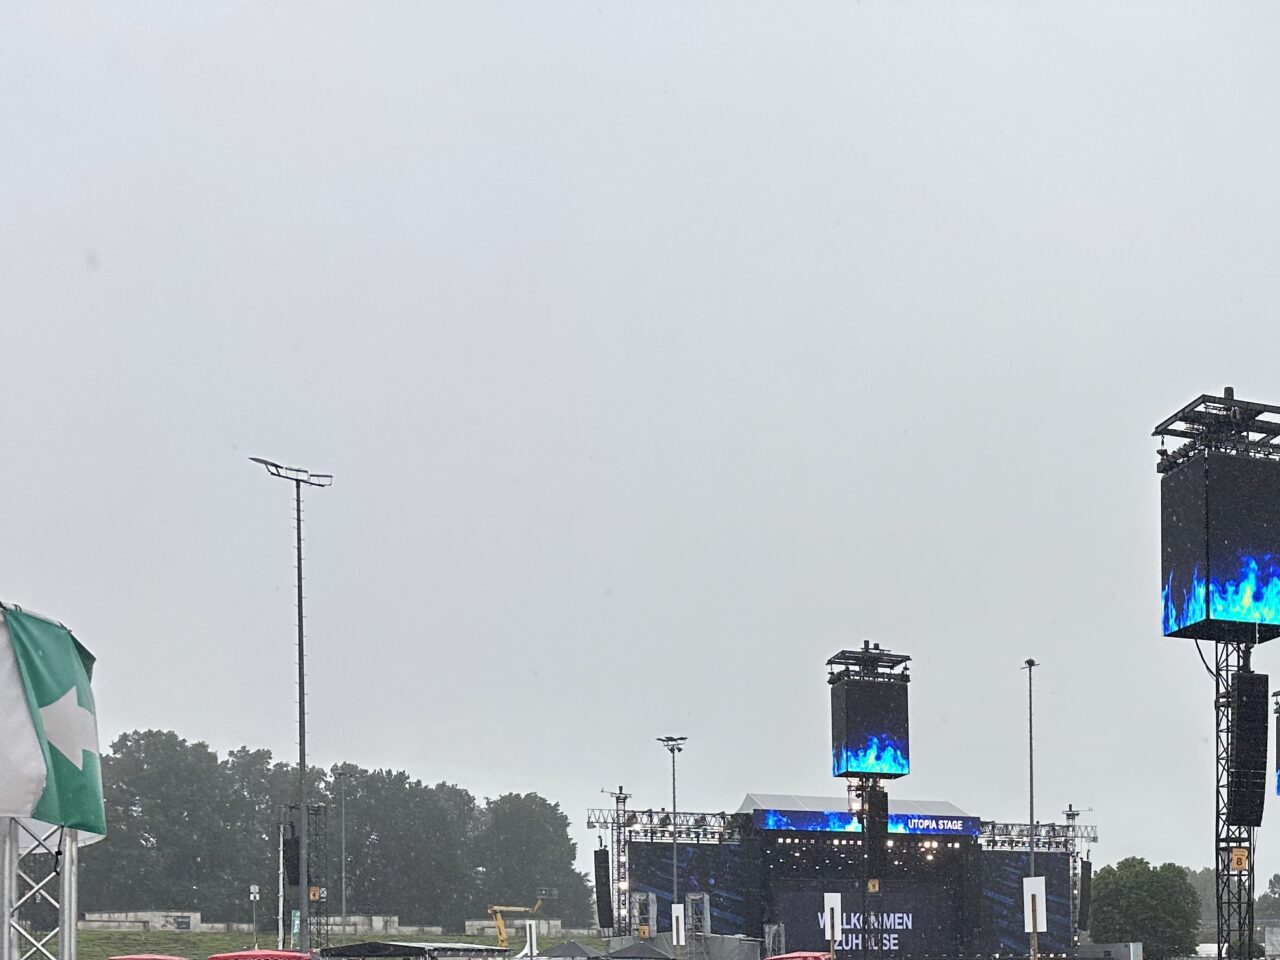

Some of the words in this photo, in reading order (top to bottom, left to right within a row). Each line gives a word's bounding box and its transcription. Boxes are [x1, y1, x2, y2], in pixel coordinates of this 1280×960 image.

[908, 819, 937, 829] UTOPIA
[938, 820, 963, 830] STAGE
[1236, 857, 1243, 866] 8
[817, 911, 912, 930] WLKMMEN
[833, 933, 899, 951] ZUHUSE
